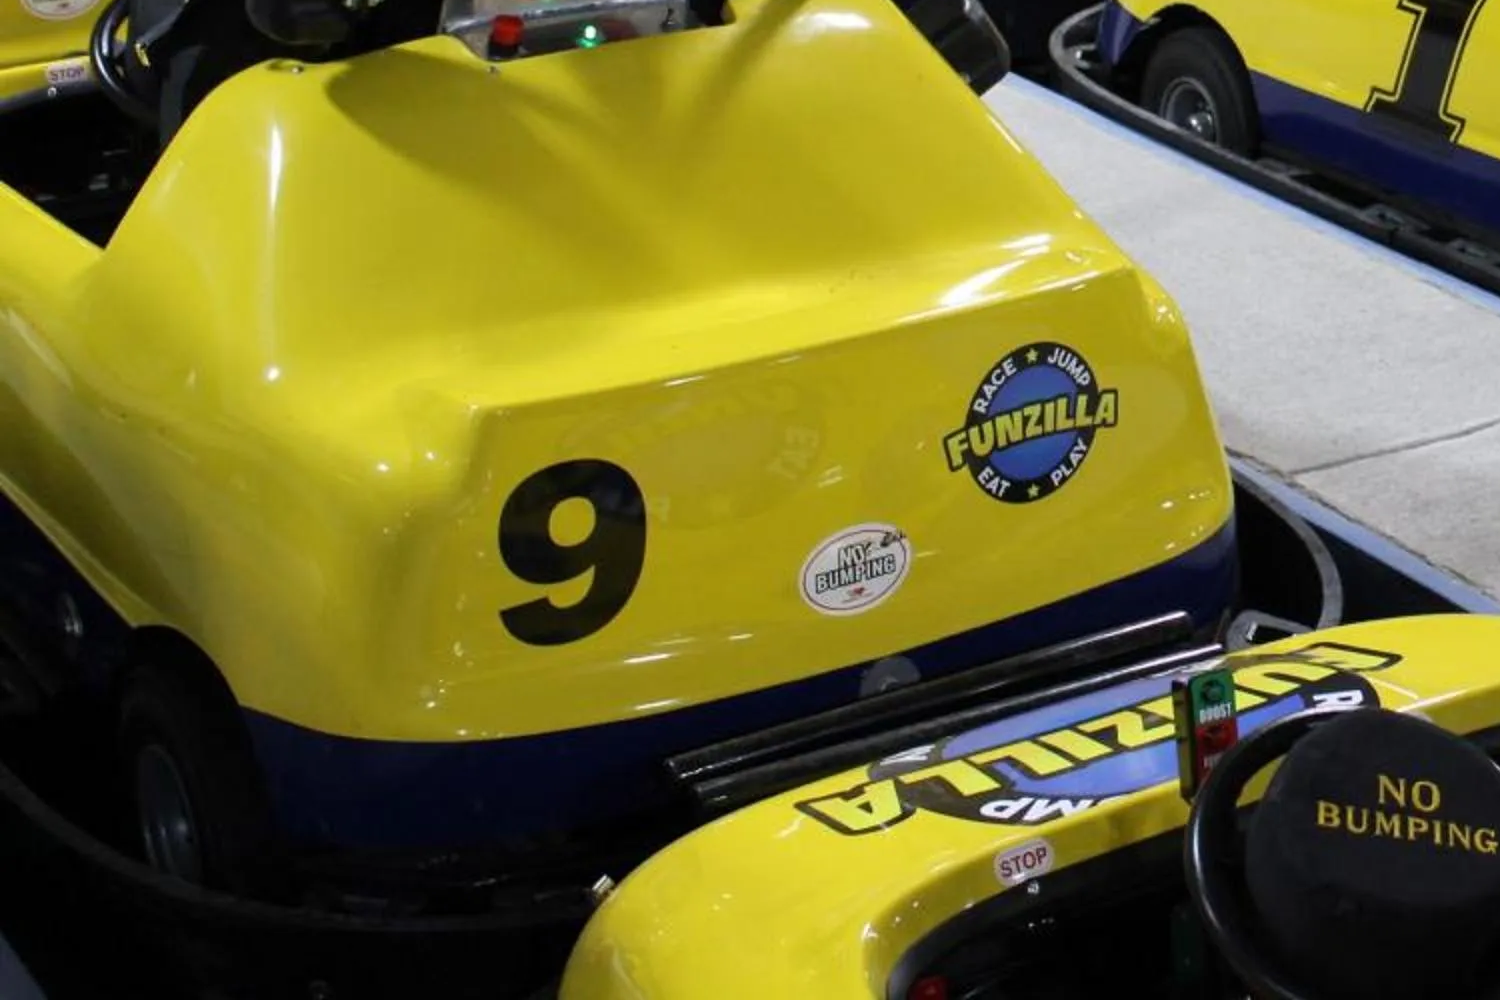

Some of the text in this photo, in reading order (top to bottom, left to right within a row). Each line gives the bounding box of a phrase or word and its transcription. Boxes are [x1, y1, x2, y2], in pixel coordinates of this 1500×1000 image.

[973, 347, 1091, 414] RACE JUMP
[945, 390, 1118, 470] FUNZILLA
[977, 436, 1088, 498] EAT PLAY
[498, 459, 646, 647] 9
[815, 553, 897, 595] BUMPING
[837, 542, 868, 568] NO
[1377, 774, 1441, 812] NO
[1316, 799, 1500, 854] BUMPING
[999, 847, 1047, 879] STOP
